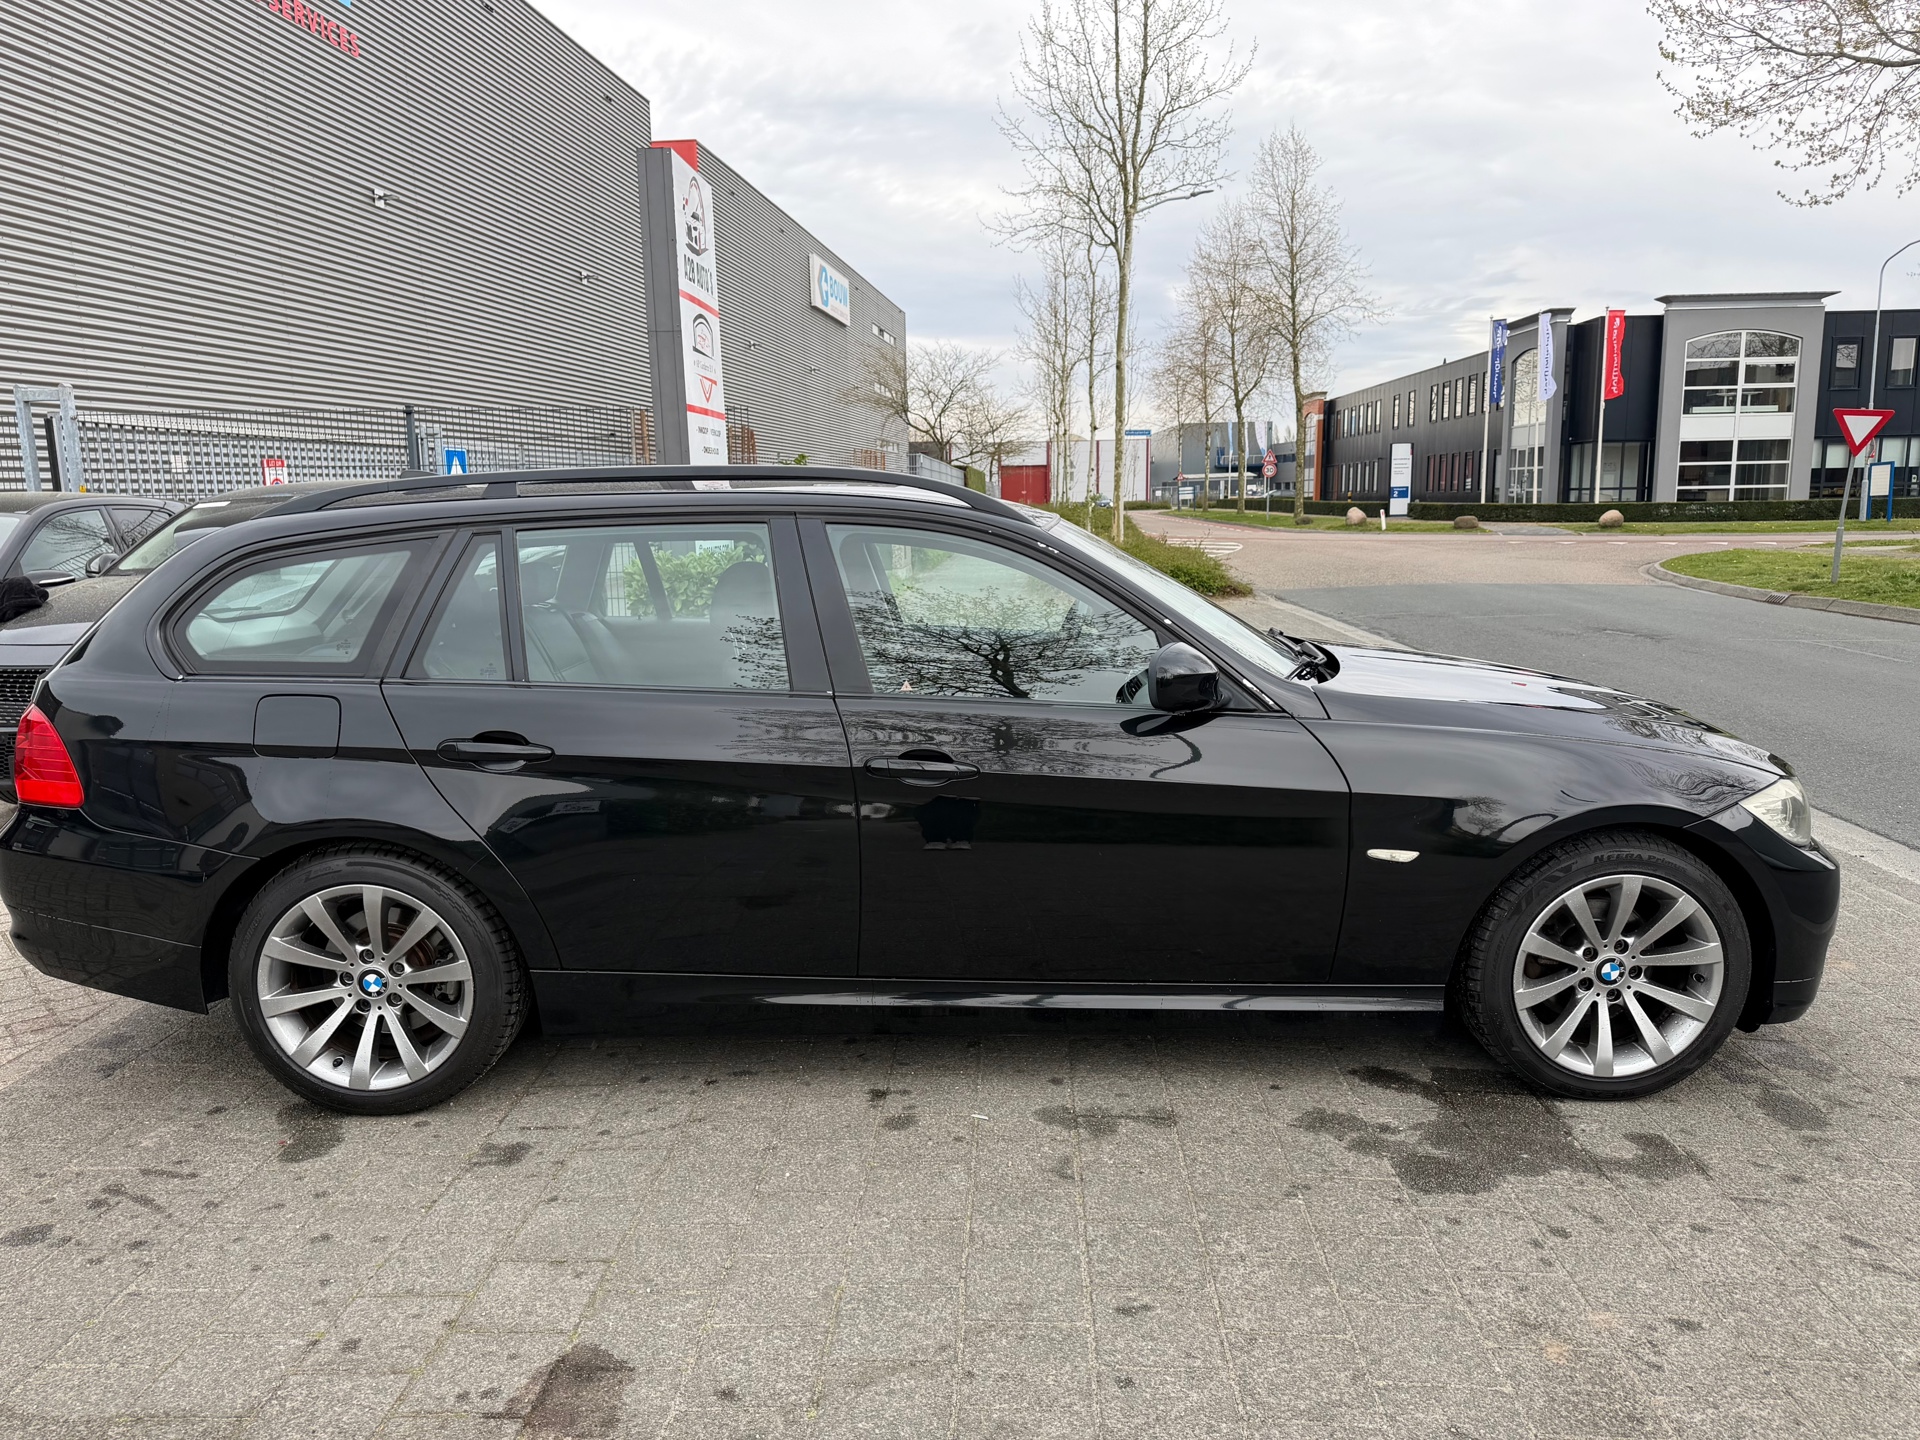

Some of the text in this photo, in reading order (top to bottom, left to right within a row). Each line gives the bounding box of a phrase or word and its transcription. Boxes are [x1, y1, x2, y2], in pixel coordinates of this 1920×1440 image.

[683, 253, 696, 284] A28
[829, 275, 848, 308] BOUW
[1393, 490, 1399, 498] 2
